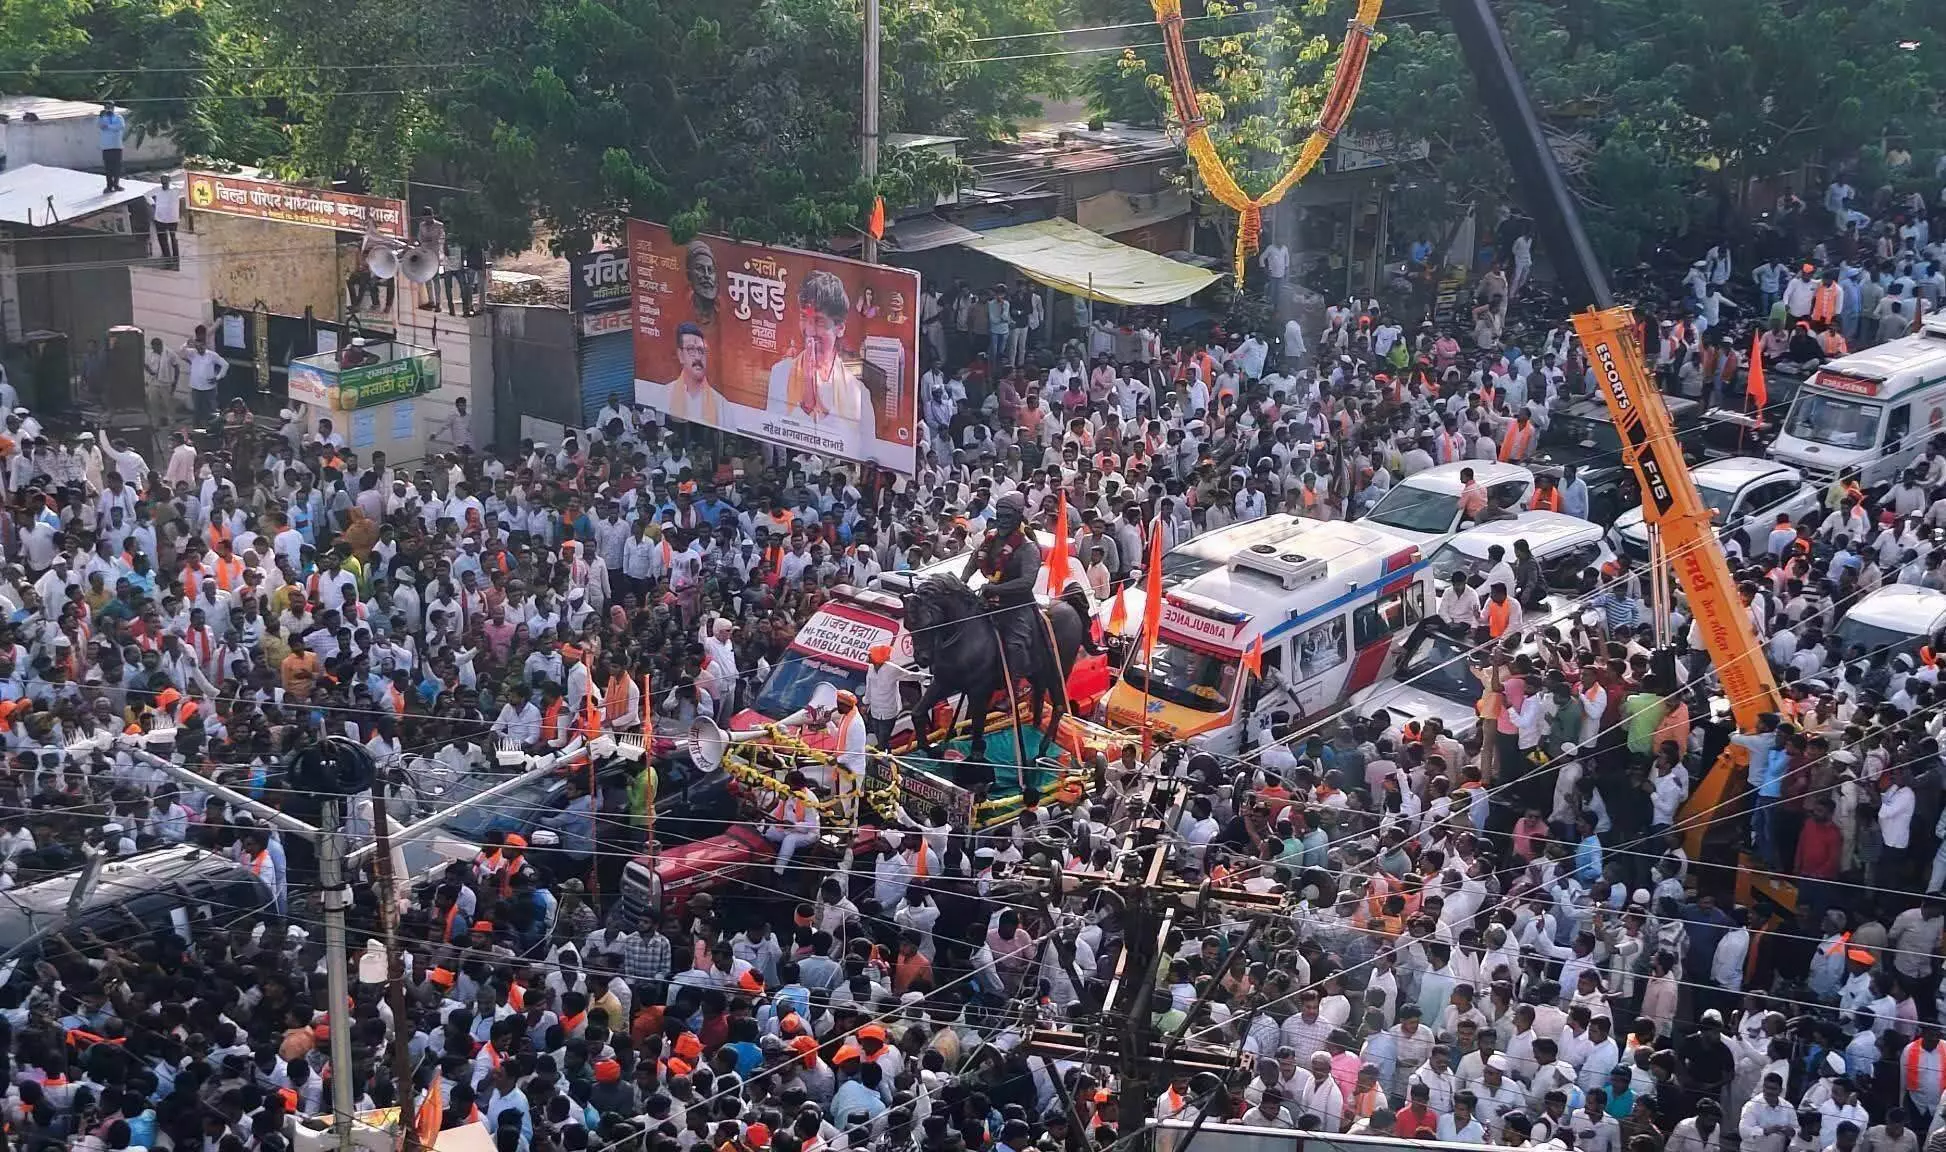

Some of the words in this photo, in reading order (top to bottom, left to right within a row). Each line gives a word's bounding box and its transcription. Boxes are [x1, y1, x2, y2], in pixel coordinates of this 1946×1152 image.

[726, 261, 788, 321] मुंबई
[1595, 342, 1631, 410] ESCORTS
[803, 626, 838, 642] HI-TECH
[840, 635, 871, 653] CARDI
[804, 636, 870, 662] AMBULANC
